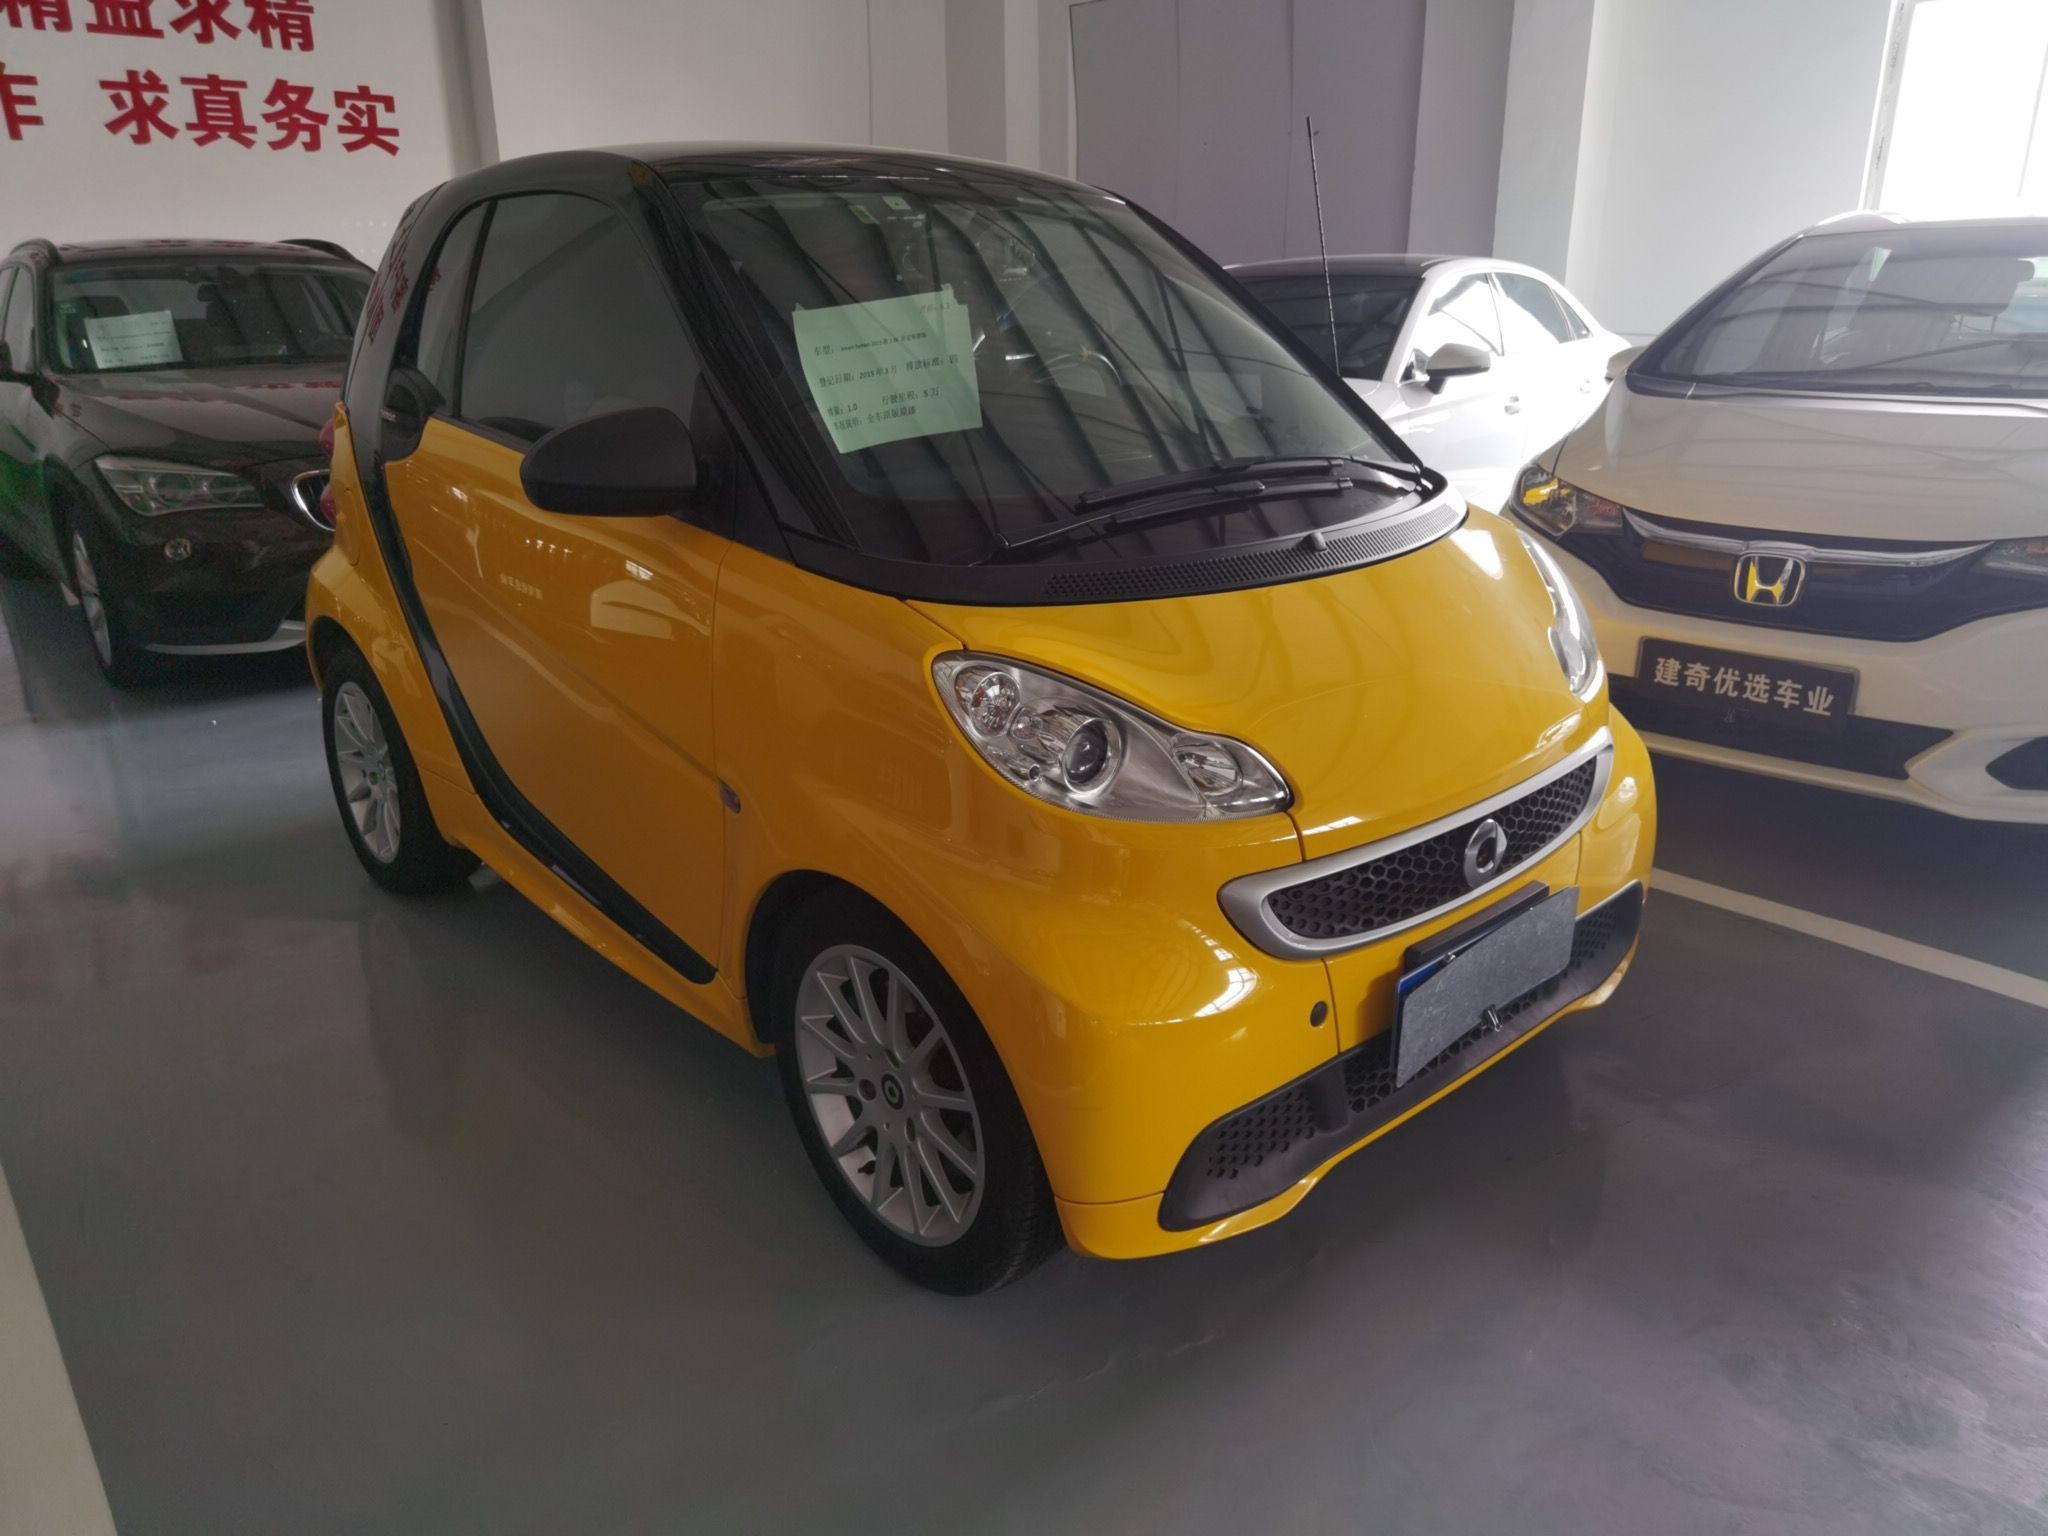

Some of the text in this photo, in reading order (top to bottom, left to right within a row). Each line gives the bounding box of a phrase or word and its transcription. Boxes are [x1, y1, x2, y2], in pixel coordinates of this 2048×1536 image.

[98, 69, 401, 157] 求真务实
[1654, 657, 1835, 716] 建奇优选车业
